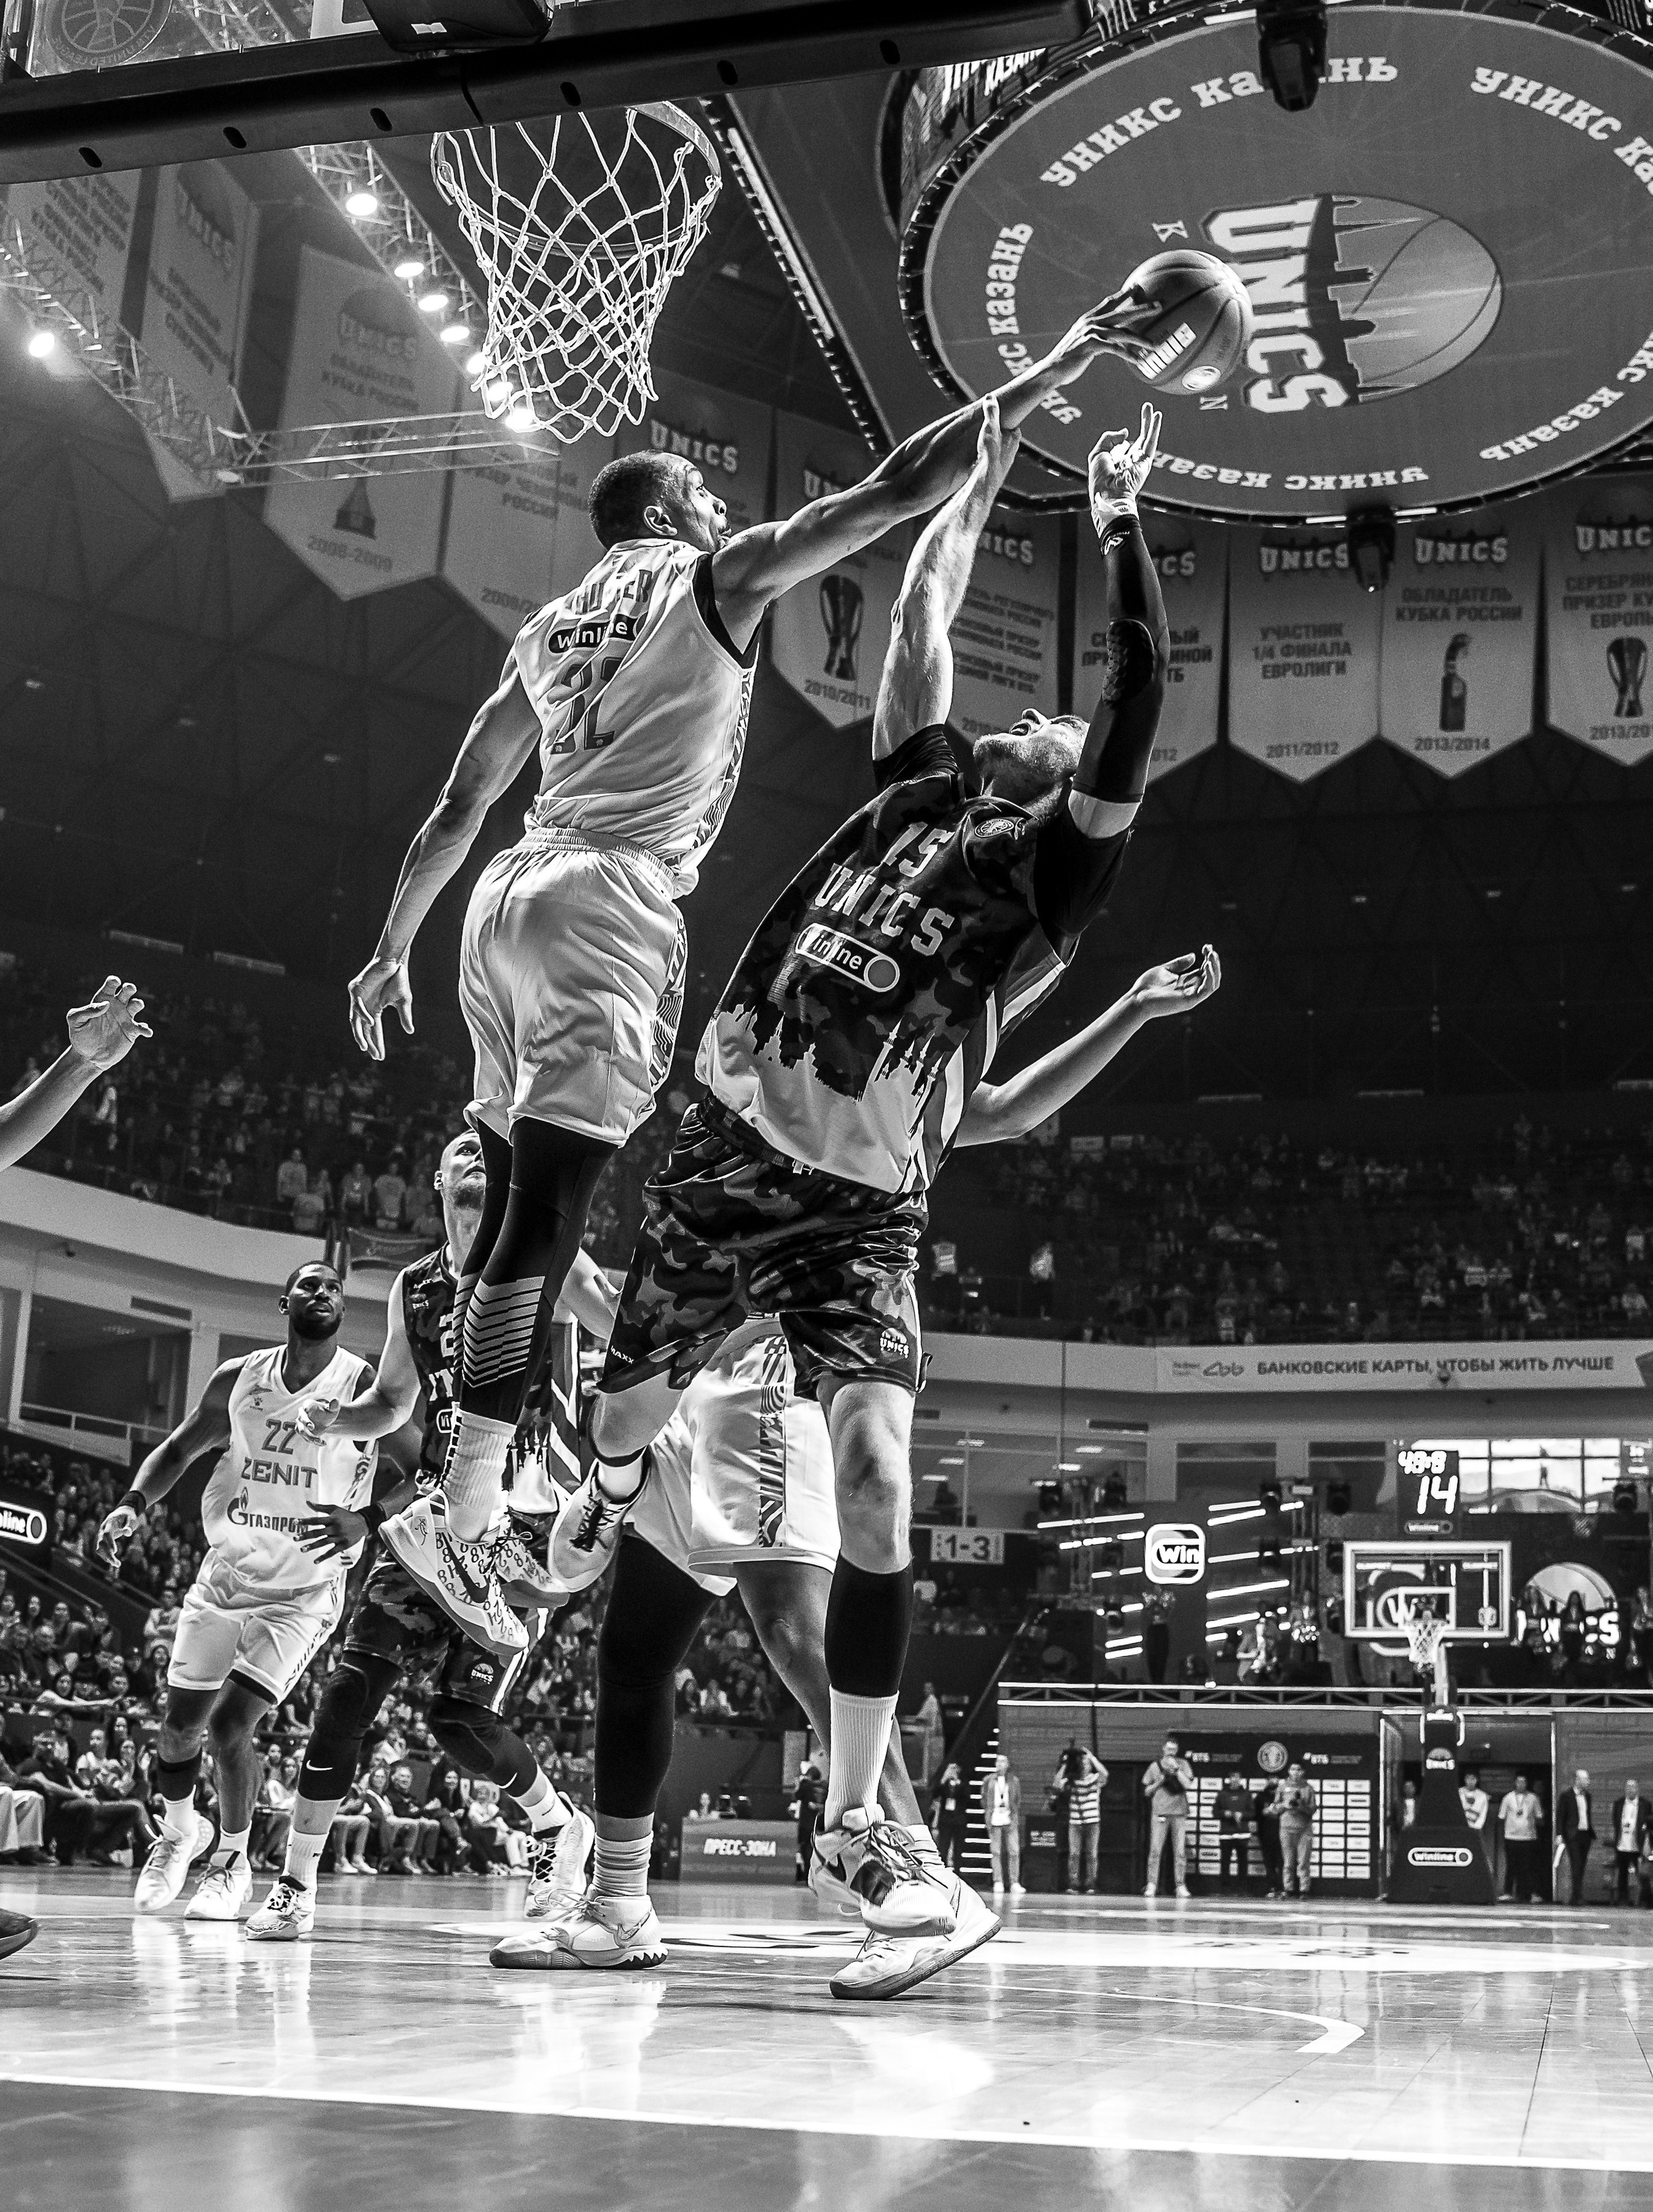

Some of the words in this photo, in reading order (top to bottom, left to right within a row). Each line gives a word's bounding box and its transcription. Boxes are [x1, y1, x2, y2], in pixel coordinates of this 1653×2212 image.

[650, 419, 738, 474] UNICS
[978, 531, 1034, 566] NICS
[1260, 543, 1349, 573] UNICS
[1414, 537, 1508, 564] UNICS
[1396, 606, 1451, 621] КУБКА
[1456, 606, 1523, 621] РОССИИ
[1260, 623, 1344, 641] УЧАСТНИК
[1252, 646, 1275, 662] 1/4
[1280, 641, 1353, 659] ФИНАЛА
[1261, 661, 1347, 679] ЕВРОЛИГИ
[1266, 741, 1339, 759] 2011/2012
[882, 822, 955, 878] 15
[810, 863, 956, 957] UNICS
[879, 1337, 910, 1356] UNICS
[1257, 1359, 1368, 1376] БАНКОВСКИЕ
[1436, 1358, 1495, 1373] ЧТОБЫ
[1499, 1357, 1548, 1372] ЖИТЬ
[1552, 1356, 1614, 1371] ЛУЧШЕ
[262, 1419, 296, 1455] 22
[240, 1456, 318, 1488] ZENIT
[1417, 1474, 1459, 1515] 14
[945, 1534, 991, 1561] 1-3
[1158, 1545, 1200, 1564] win
[471, 1669, 494, 1682] UNICS
